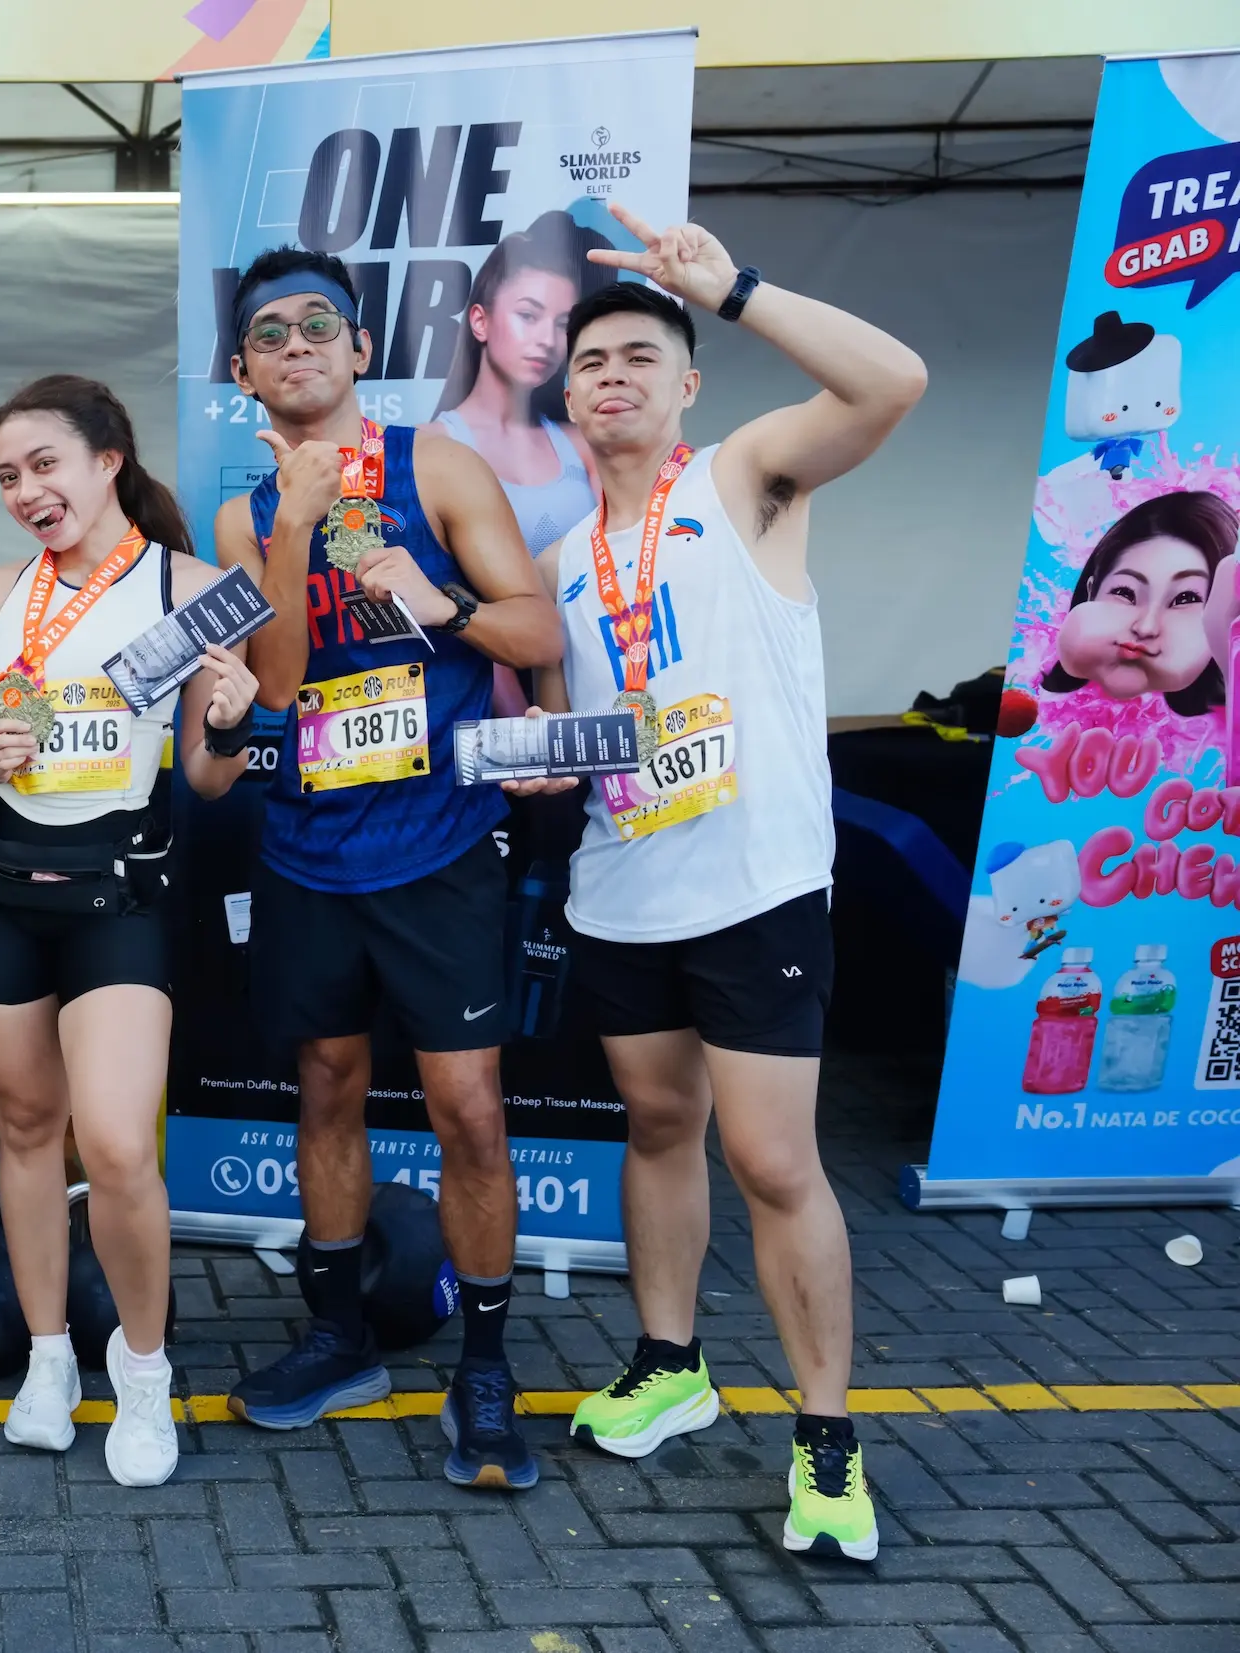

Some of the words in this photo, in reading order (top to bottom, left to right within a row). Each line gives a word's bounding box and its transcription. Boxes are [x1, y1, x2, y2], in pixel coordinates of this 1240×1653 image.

[559, 150, 642, 168] SLIMMERS
[569, 166, 631, 181] WORLD
[297, 121, 523, 252] ONE
[586, 184, 613, 194] ELITE
[1117, 226, 1210, 277] GRAB
[246, 473, 263, 482] For
[364, 467, 377, 496] 12K
[640, 516, 659, 587] JCORUN
[650, 492, 665, 513] PH
[63, 555, 127, 621] FINISHER
[600, 568, 615, 596] 12K
[37, 622, 67, 650] 12K
[105, 700, 121, 708] 2025
[332, 685, 361, 702] JCO
[689, 703, 712, 722] RU
[707, 715, 723, 725] 2025
[301, 725, 315, 750] M
[341, 707, 418, 749] 13876
[647, 734, 725, 789] 13877
[1015, 720, 1162, 804] YOU
[604, 774, 623, 801] M
[522, 940, 568, 955] SLIMMERS
[526, 949, 560, 961] WORLD
[1221, 956, 1240, 972] SC
[200, 1077, 245, 1090] Premium
[246, 1079, 278, 1092] Duffle
[366, 1087, 409, 1100] Sessions
[513, 1096, 542, 1108] Deep
[544, 1097, 578, 1109] Tissue
[580, 1099, 626, 1113] Massage
[1015, 1102, 1088, 1130] No.1
[1090, 1110, 1148, 1128] NATA
[1152, 1110, 1180, 1127] DE
[240, 1132, 269, 1146] ASK
[275, 1133, 298, 1148] OU
[369, 1140, 417, 1156] TANTS
[423, 1143, 443, 1158] FO
[510, 1148, 574, 1165] DETAILS
